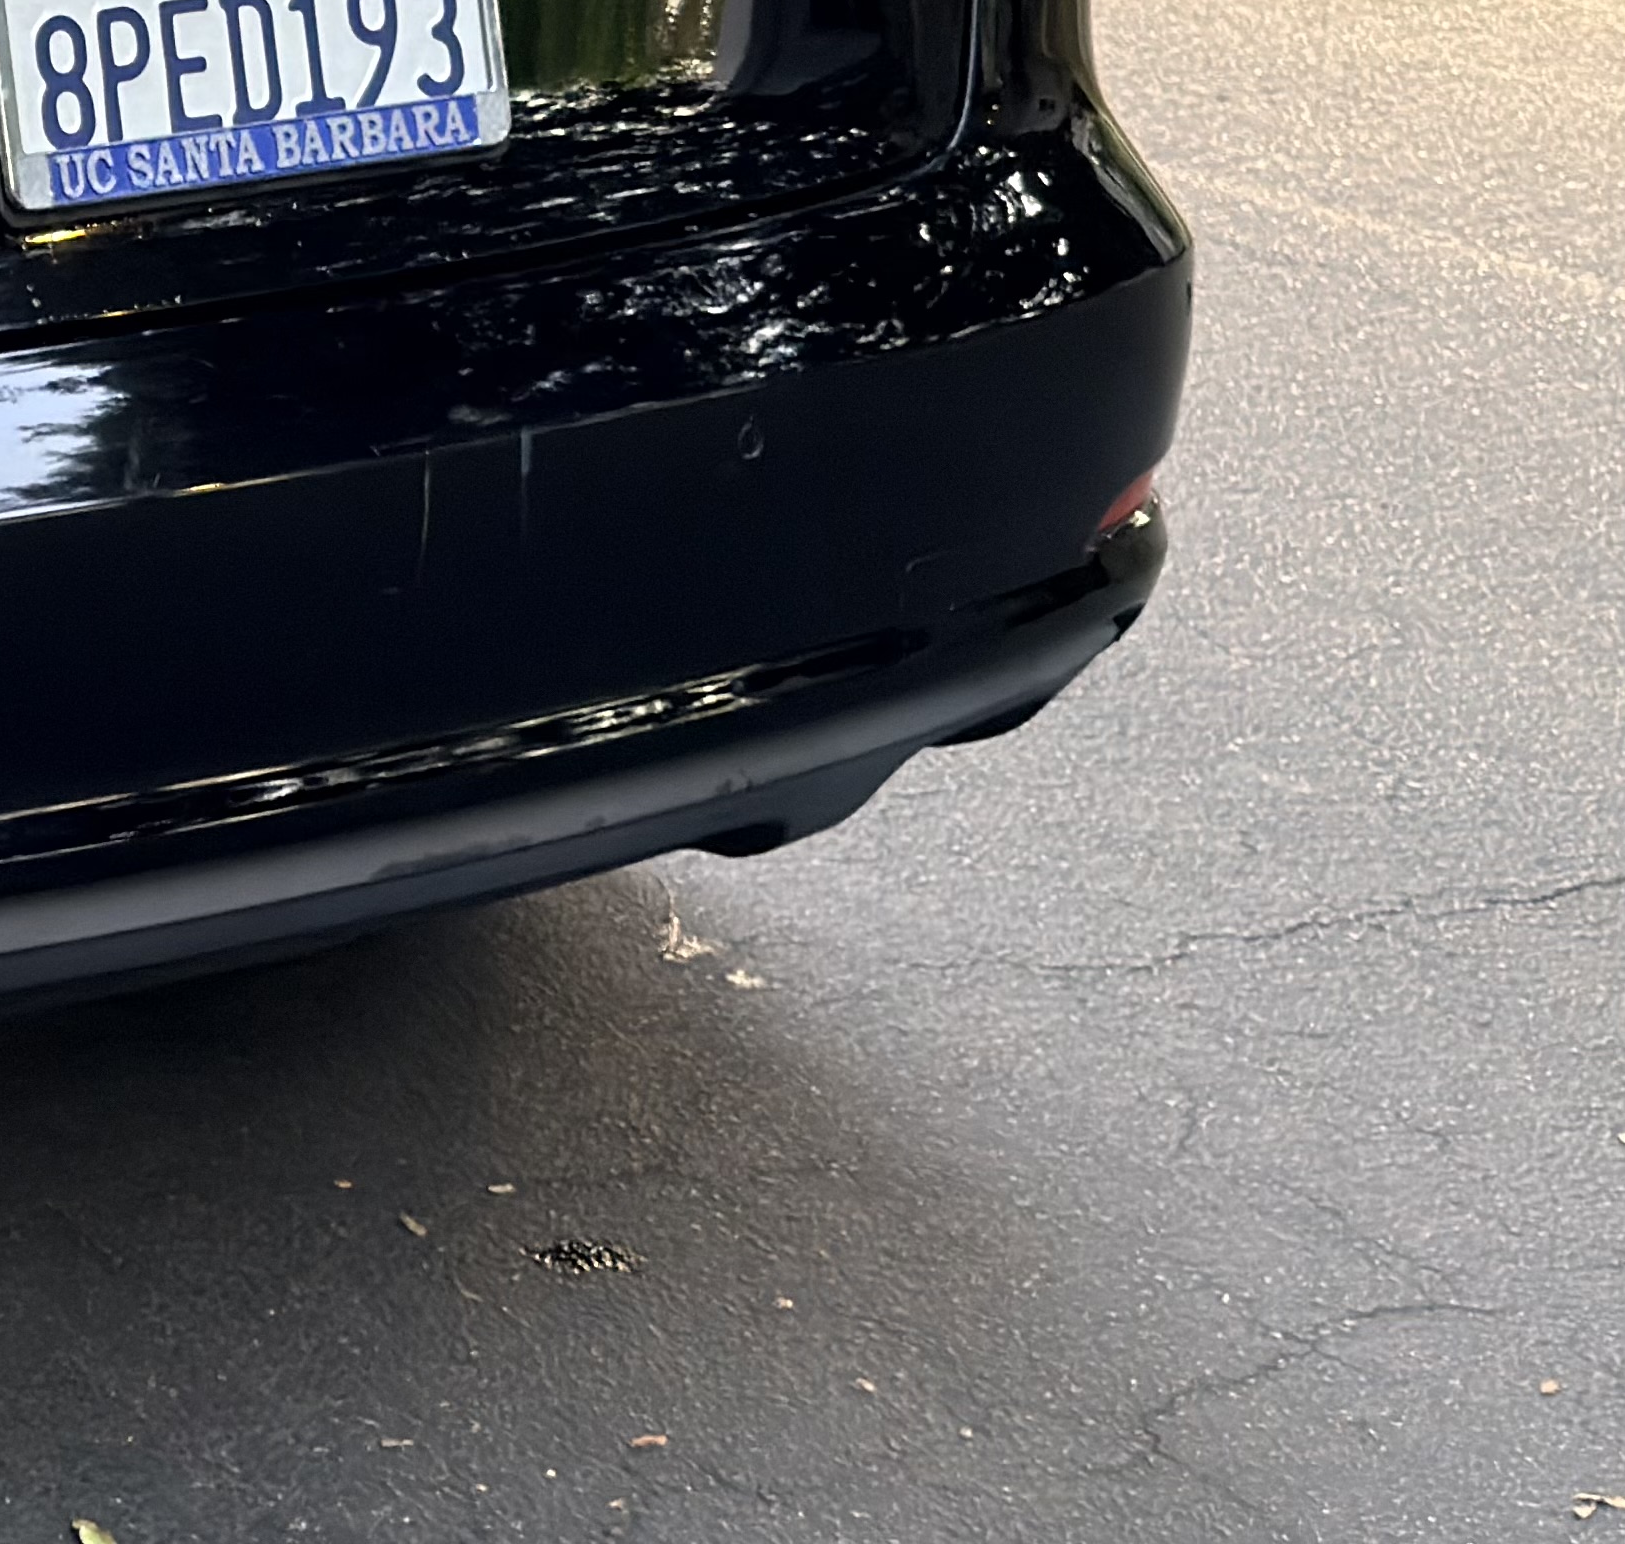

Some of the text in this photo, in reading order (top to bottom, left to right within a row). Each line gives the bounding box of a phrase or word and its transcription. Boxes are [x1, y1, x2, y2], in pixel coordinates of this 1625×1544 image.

[54, 104, 472, 200] UC SANTA BARBARA
